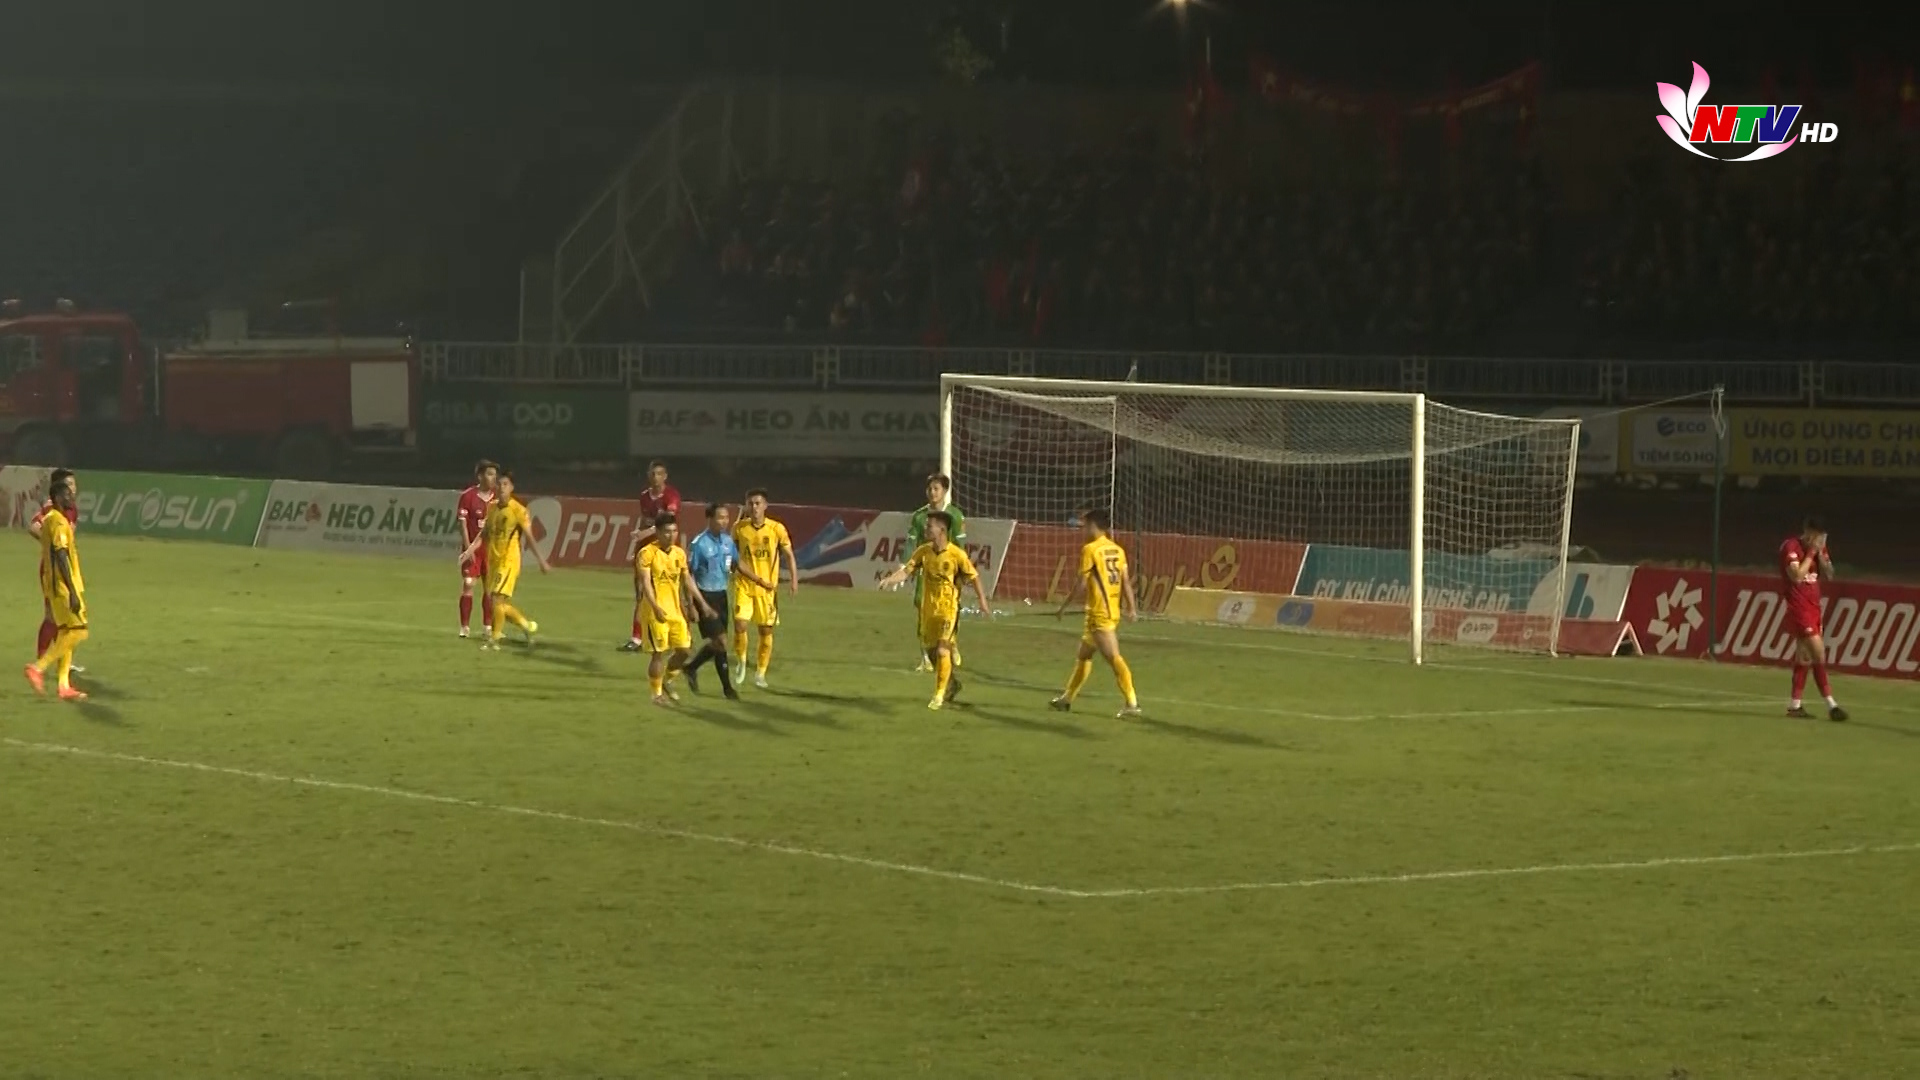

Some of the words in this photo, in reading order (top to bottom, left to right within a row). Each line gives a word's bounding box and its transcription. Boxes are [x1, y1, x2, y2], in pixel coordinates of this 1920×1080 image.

[637, 408, 691, 428] BAF
[725, 409, 794, 431] HEO
[803, 404, 851, 432] ĂN
[1677, 421, 1706, 434] ECO
[268, 501, 308, 522] BAF
[326, 503, 374, 530] HEO
[377, 498, 414, 533] ĂN
[558, 513, 630, 560] FPT
